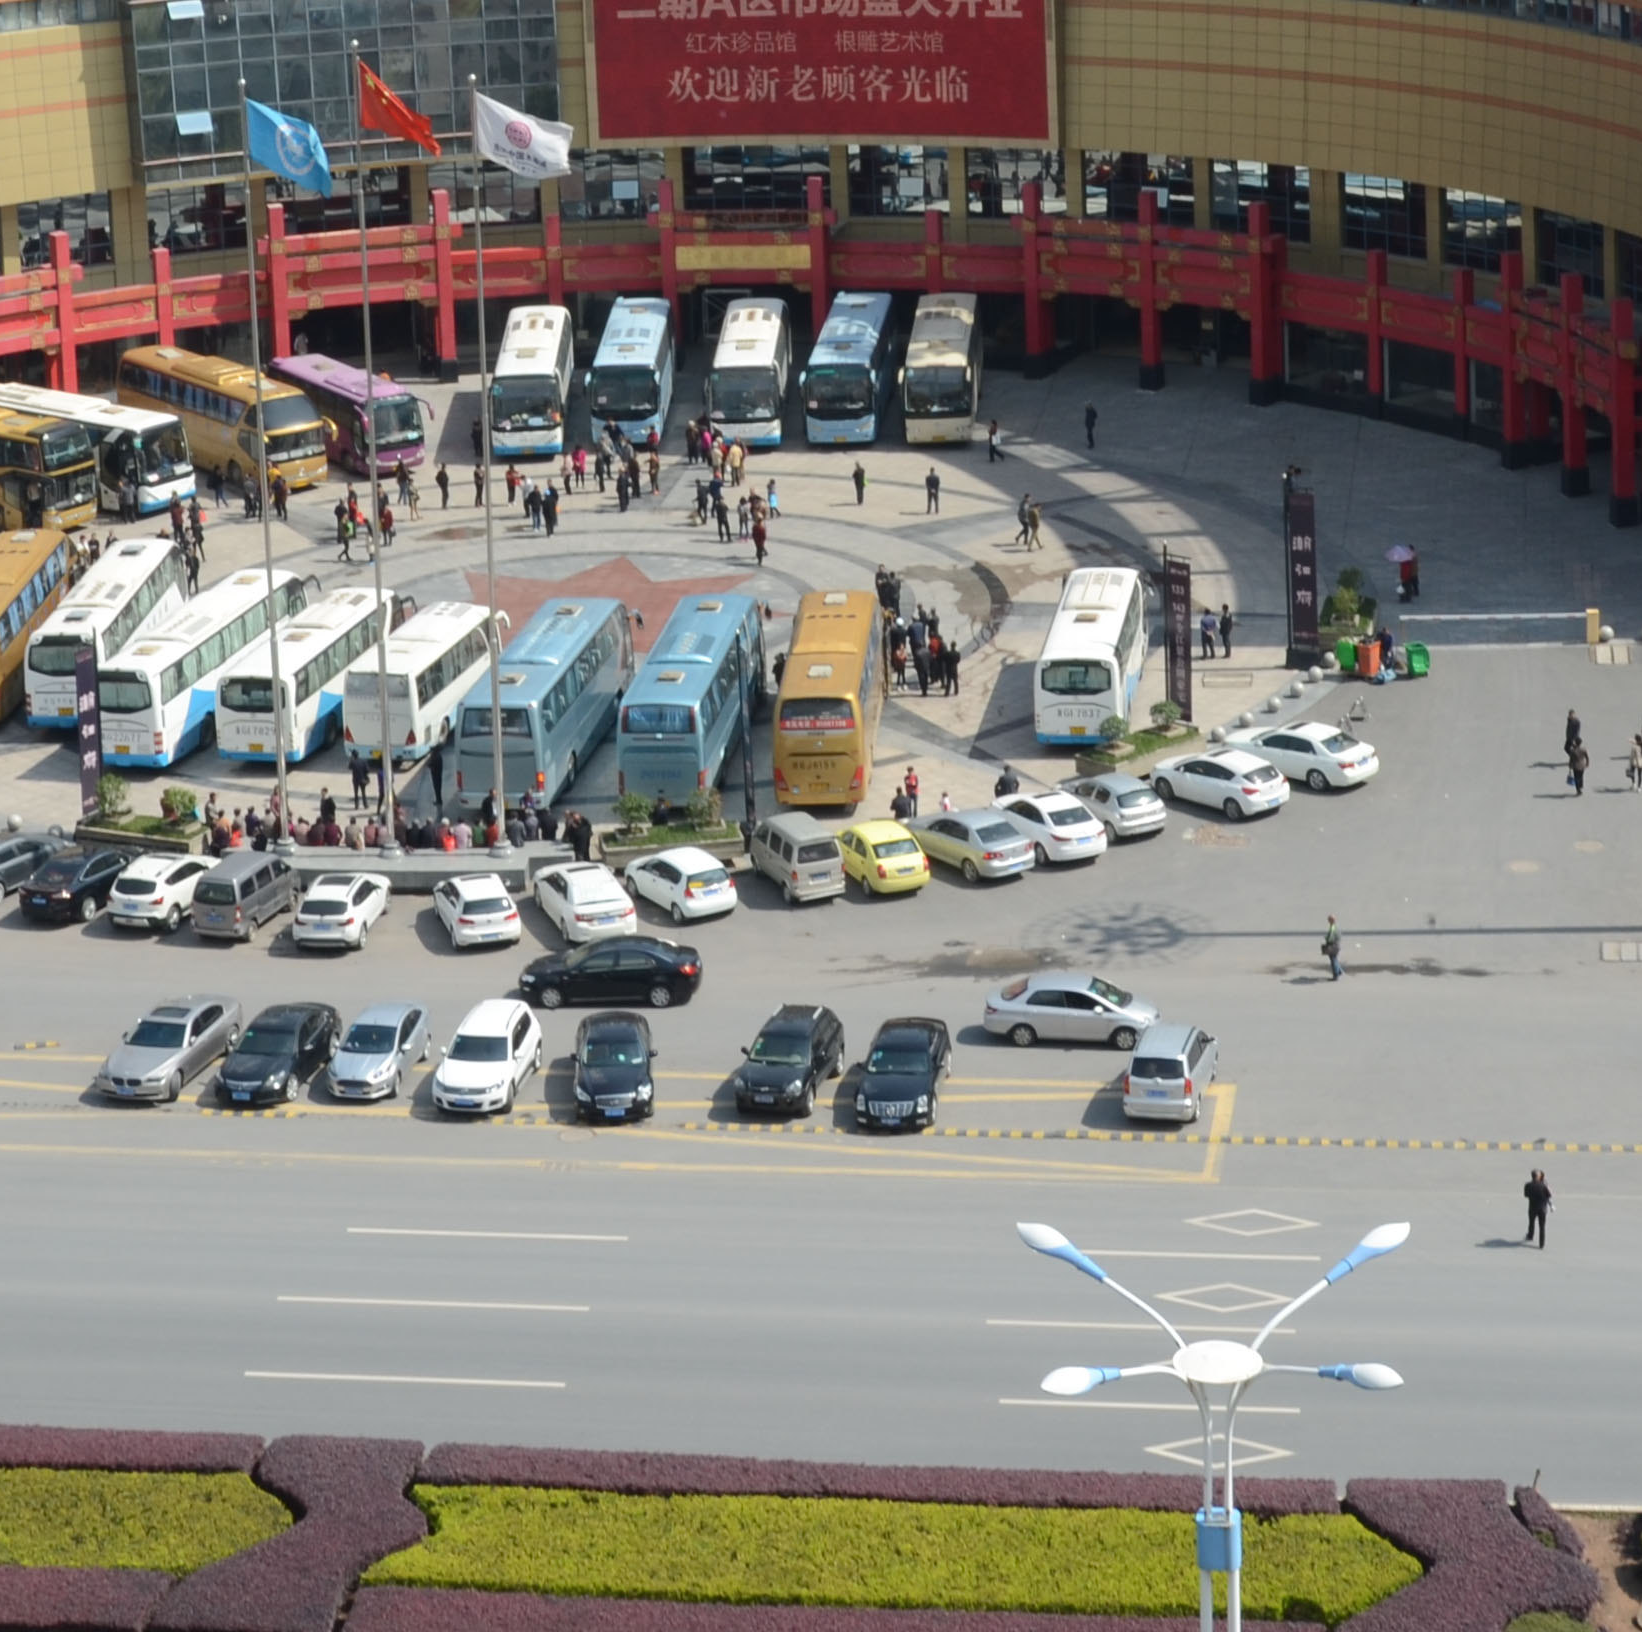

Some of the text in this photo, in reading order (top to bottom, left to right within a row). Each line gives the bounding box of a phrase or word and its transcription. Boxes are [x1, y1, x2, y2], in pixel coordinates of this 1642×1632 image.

[685, 29, 945, 55] 红木珍品馆 根雕艺术馆
[666, 64, 970, 105] 欢迎新老顾客光临
